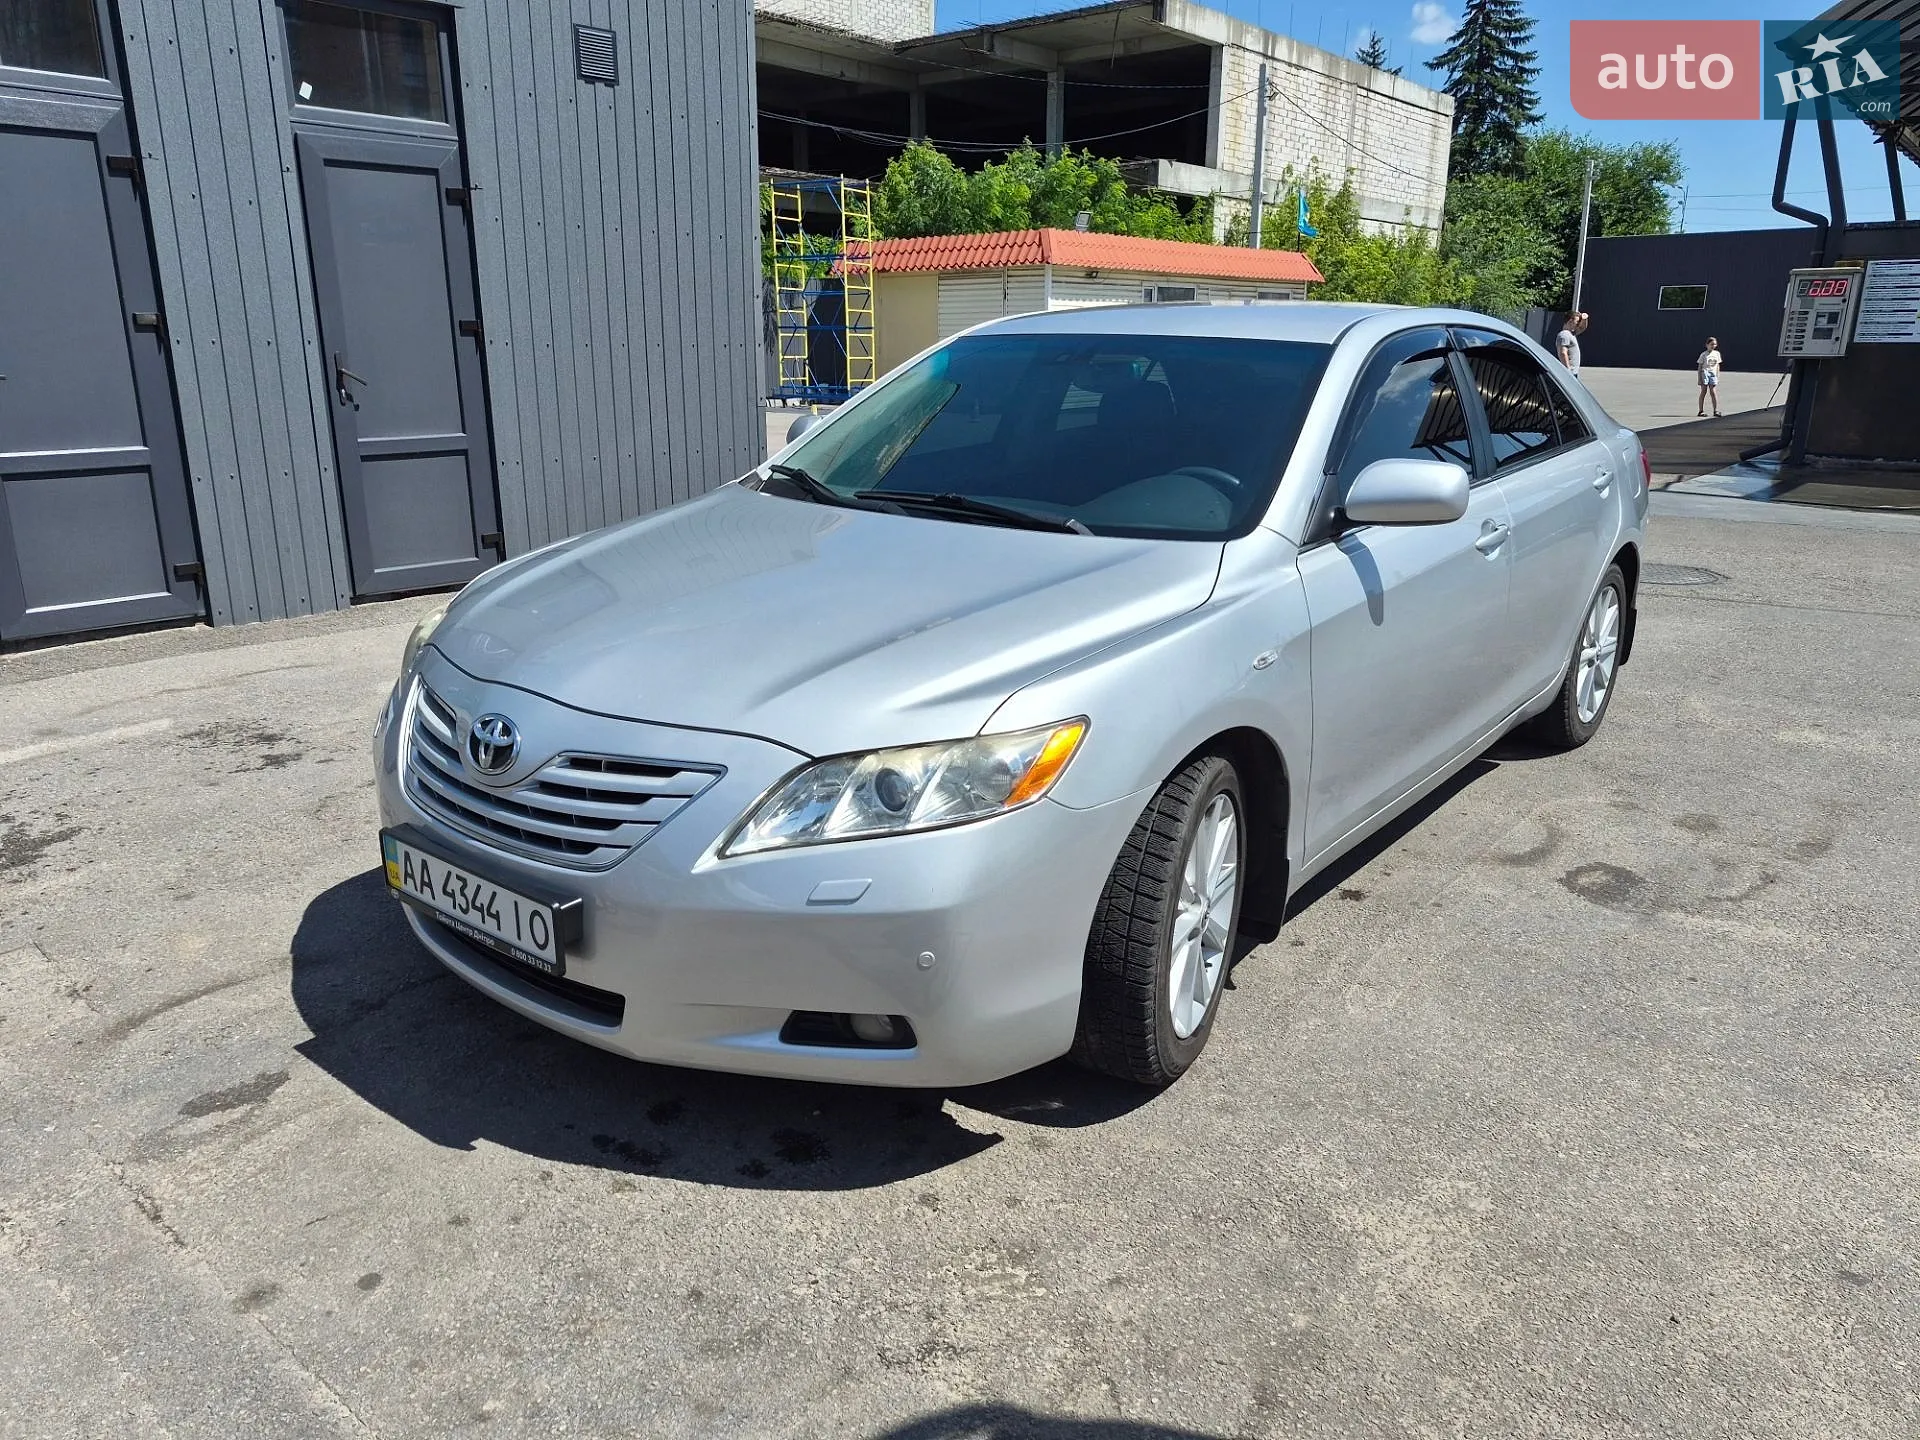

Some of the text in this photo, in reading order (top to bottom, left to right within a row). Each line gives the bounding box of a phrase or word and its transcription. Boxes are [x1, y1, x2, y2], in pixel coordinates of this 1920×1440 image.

[404, 850, 549, 950] AA 4344 IO
